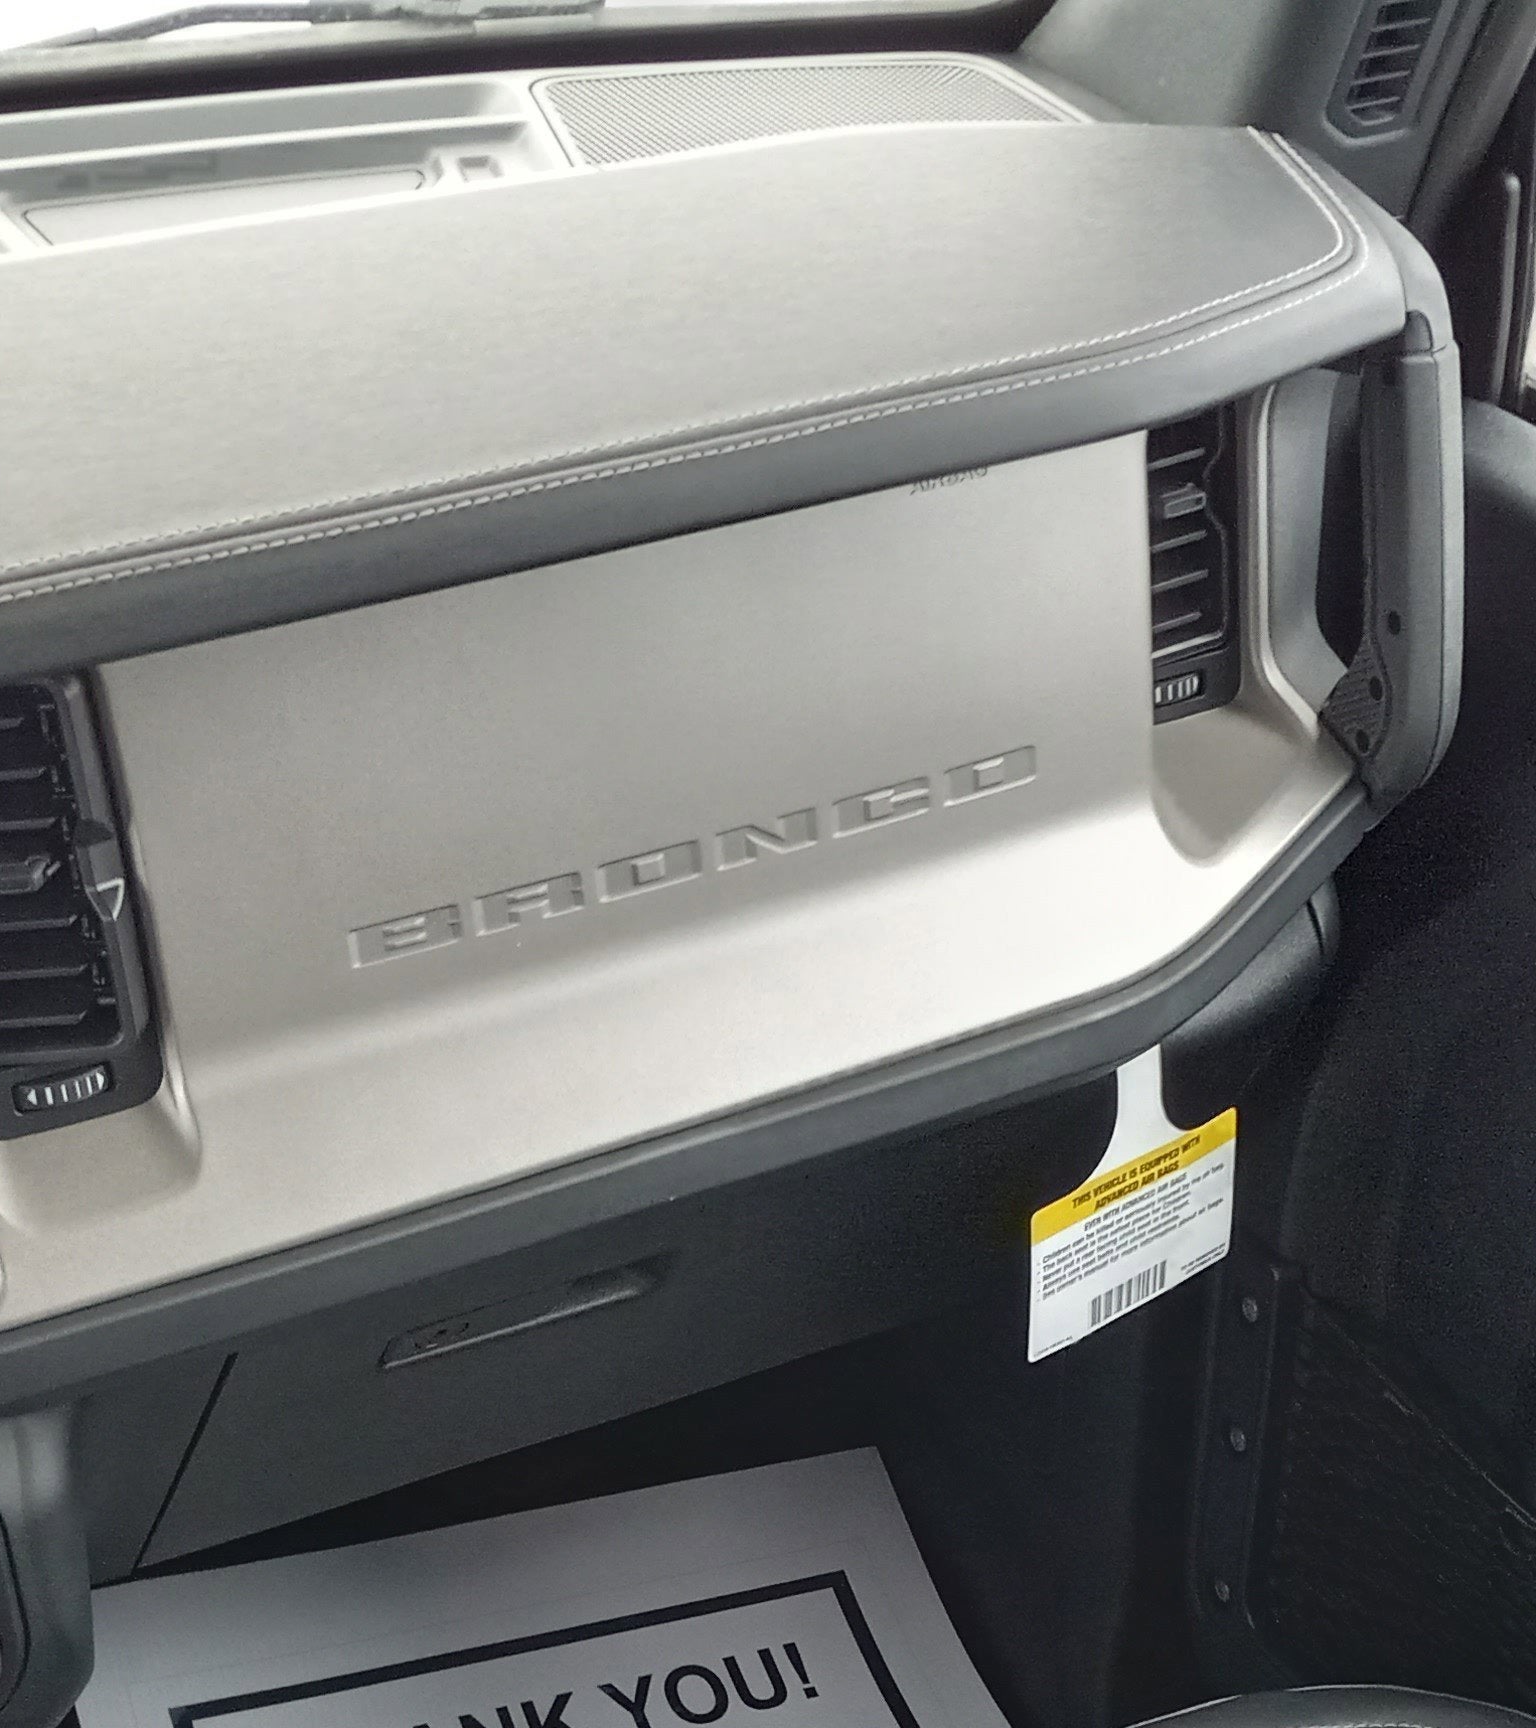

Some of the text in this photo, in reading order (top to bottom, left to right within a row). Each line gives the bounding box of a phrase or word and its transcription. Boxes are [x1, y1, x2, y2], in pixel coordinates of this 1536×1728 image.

[347, 744, 1037, 969] BRONCO
[1072, 1191, 1090, 1208] THIS
[1092, 1172, 1127, 1198] VEHICLE
[1129, 1167, 1136, 1178] IS
[1139, 1146, 1179, 1174] EQUIPPED
[1094, 1159, 1179, 1210] ADVANCED AIR BAGS
